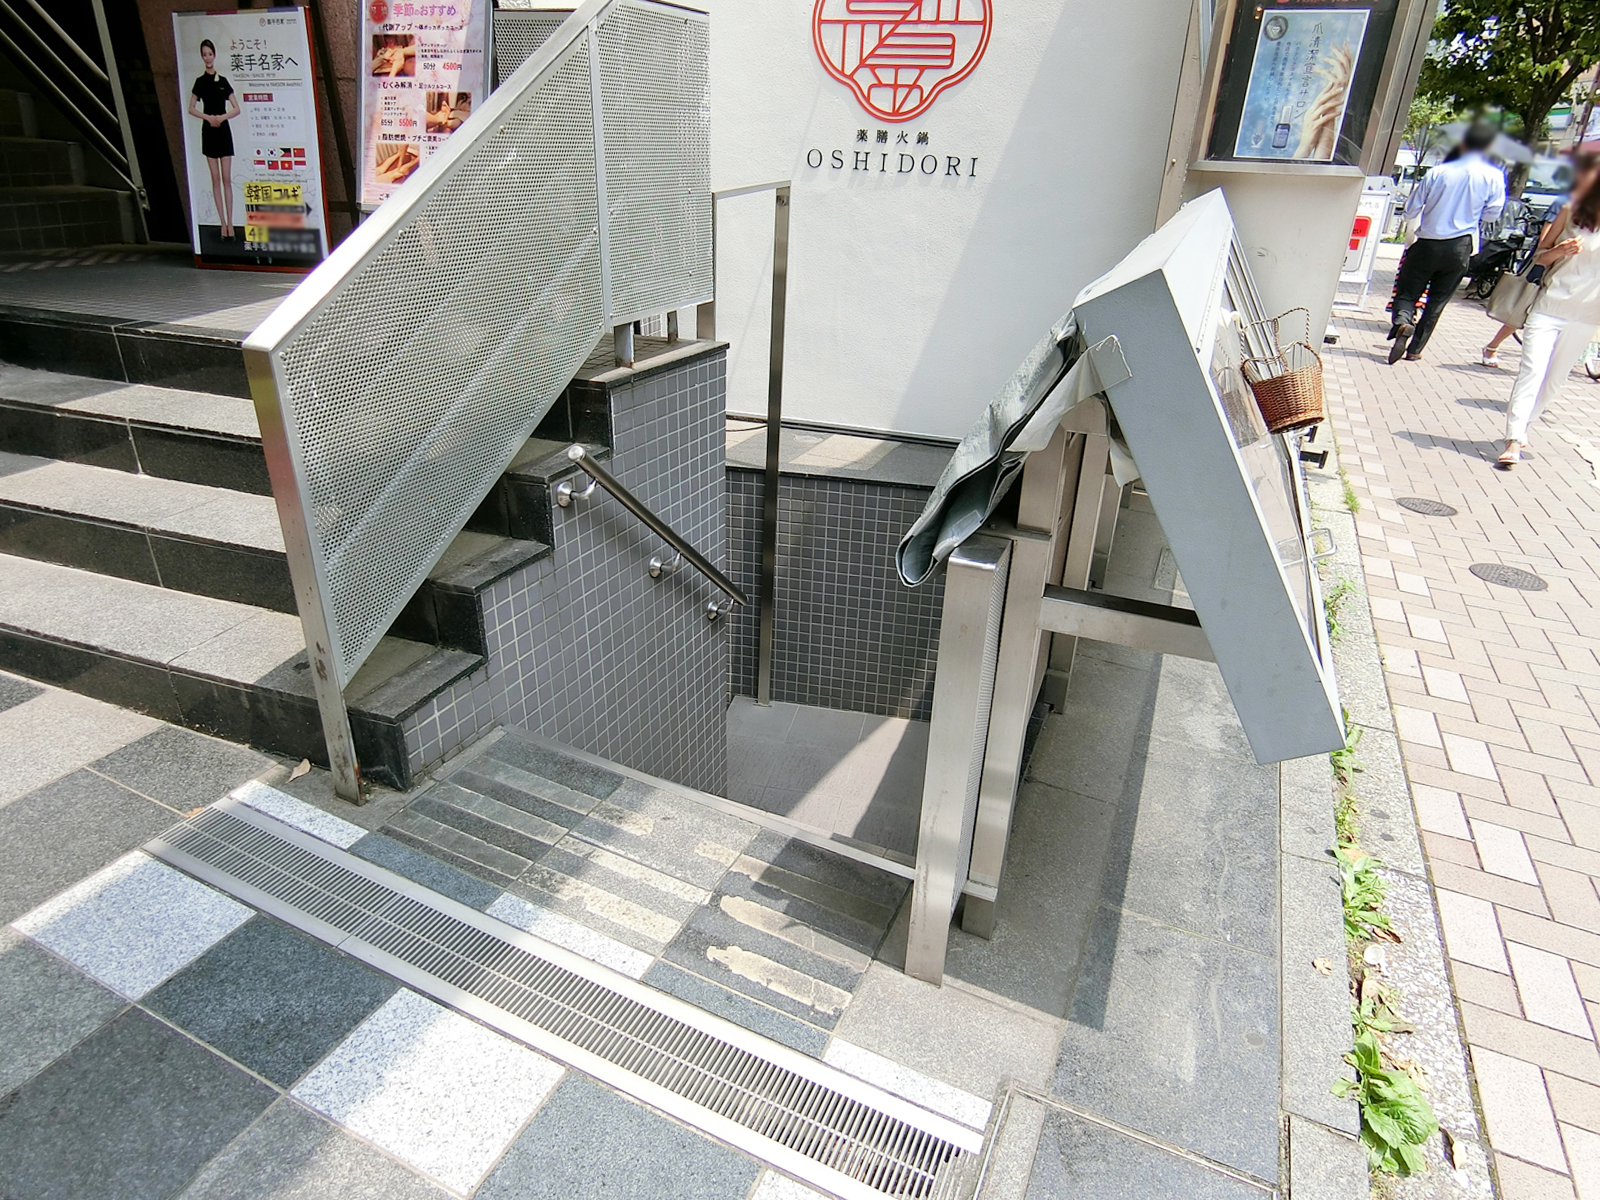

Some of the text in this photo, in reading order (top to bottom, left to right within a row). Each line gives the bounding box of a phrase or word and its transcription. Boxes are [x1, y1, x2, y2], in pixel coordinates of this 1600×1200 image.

[393, 3, 457, 17] 季節のおすすめ
[230, 52, 299, 72] 薬手名家へ
[442, 62, 463, 71] 4500円
[398, 118, 418, 128] 5500円
[856, 129, 930, 146] 薬膳火鍋
[806, 148, 979, 178] OSHIDORI
